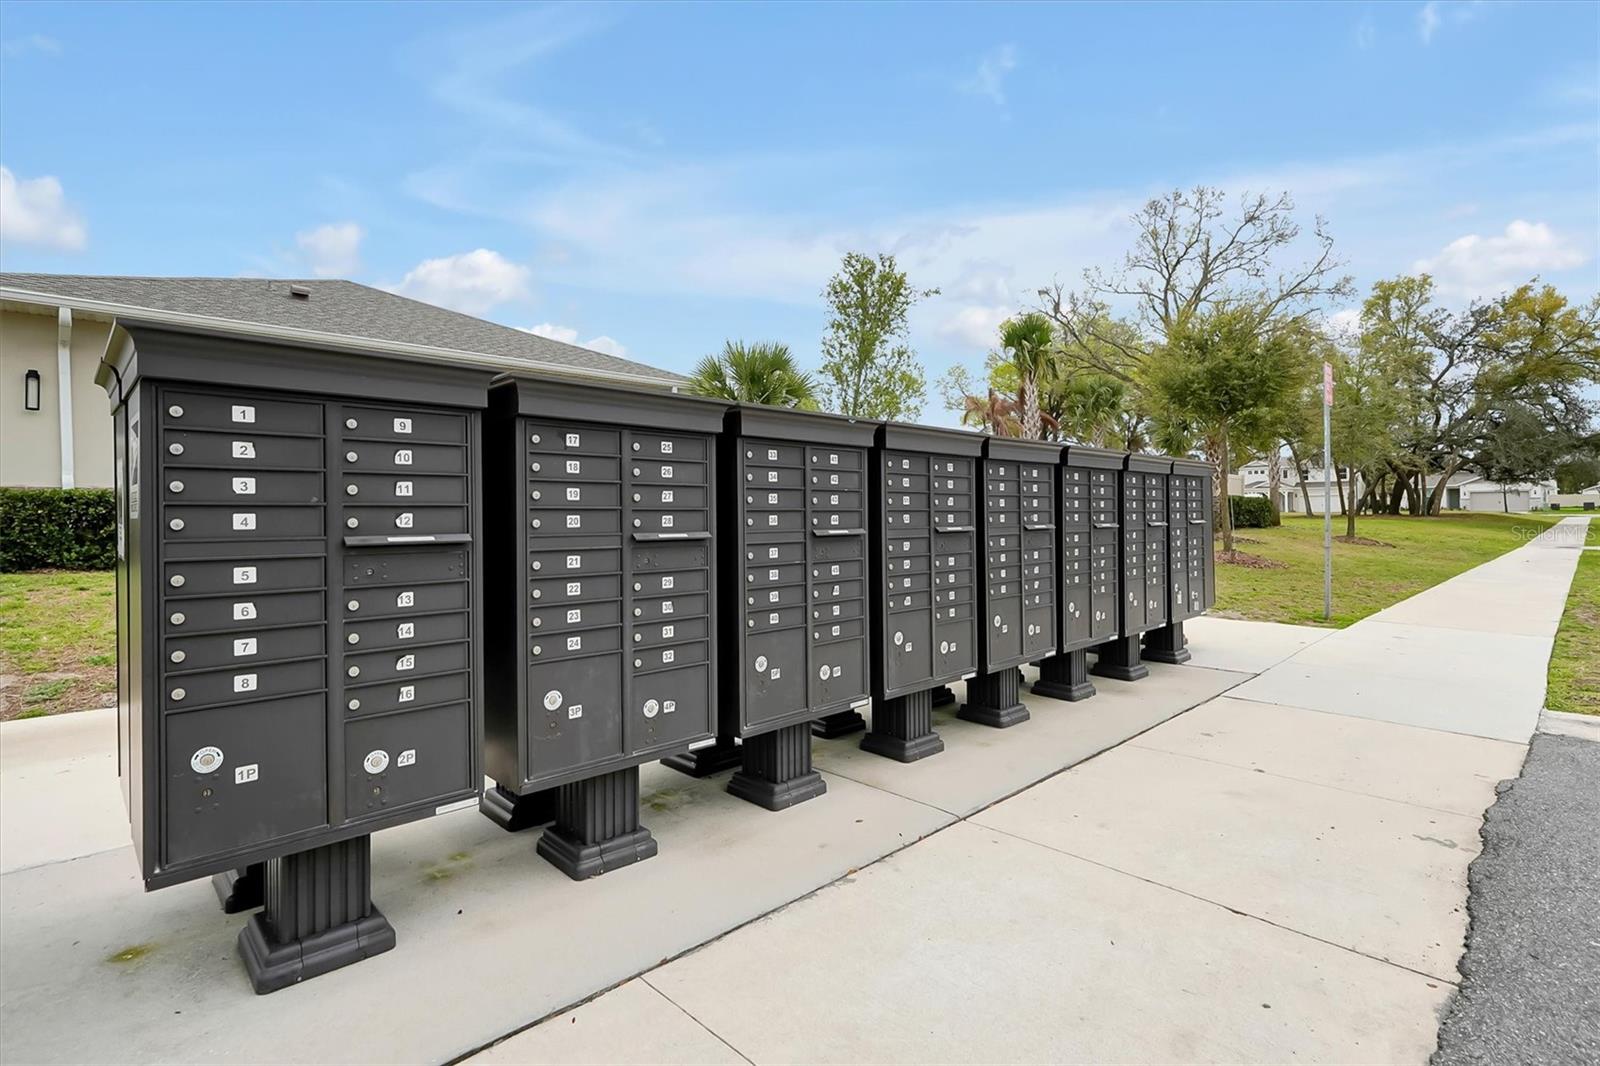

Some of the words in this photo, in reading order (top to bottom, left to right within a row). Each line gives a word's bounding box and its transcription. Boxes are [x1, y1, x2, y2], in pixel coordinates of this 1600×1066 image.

[240, 410, 246, 420] 1
[399, 422, 406, 430] 9
[568, 436, 578, 444] 17
[240, 445, 248, 456] 2
[397, 452, 410, 462] 10
[569, 463, 578, 471] 18
[662, 468, 671, 476] 26
[240, 481, 248, 492] 3
[398, 485, 410, 494] 11
[240, 517, 249, 527] 4
[398, 516, 411, 525] 12
[568, 517, 579, 525] 20
[568, 558, 578, 566] 21
[241, 571, 249, 581] 5
[664, 579, 672, 587] 29
[569, 585, 579, 593] 22
[399, 595, 412, 605] 13
[241, 606, 249, 616] 6
[664, 603, 672, 611] 30
[569, 612, 579, 620] 23
[399, 626, 412, 636] 14
[664, 628, 672, 636] 31
[241, 642, 249, 652] 7
[569, 639, 579, 648] 24
[400, 657, 412, 668] 15
[241, 678, 249, 688] 8
[400, 689, 412, 699] 16
[570, 707, 581, 716] 3P
[400, 753, 414, 764] 2P
[238, 768, 256, 780] 1P
